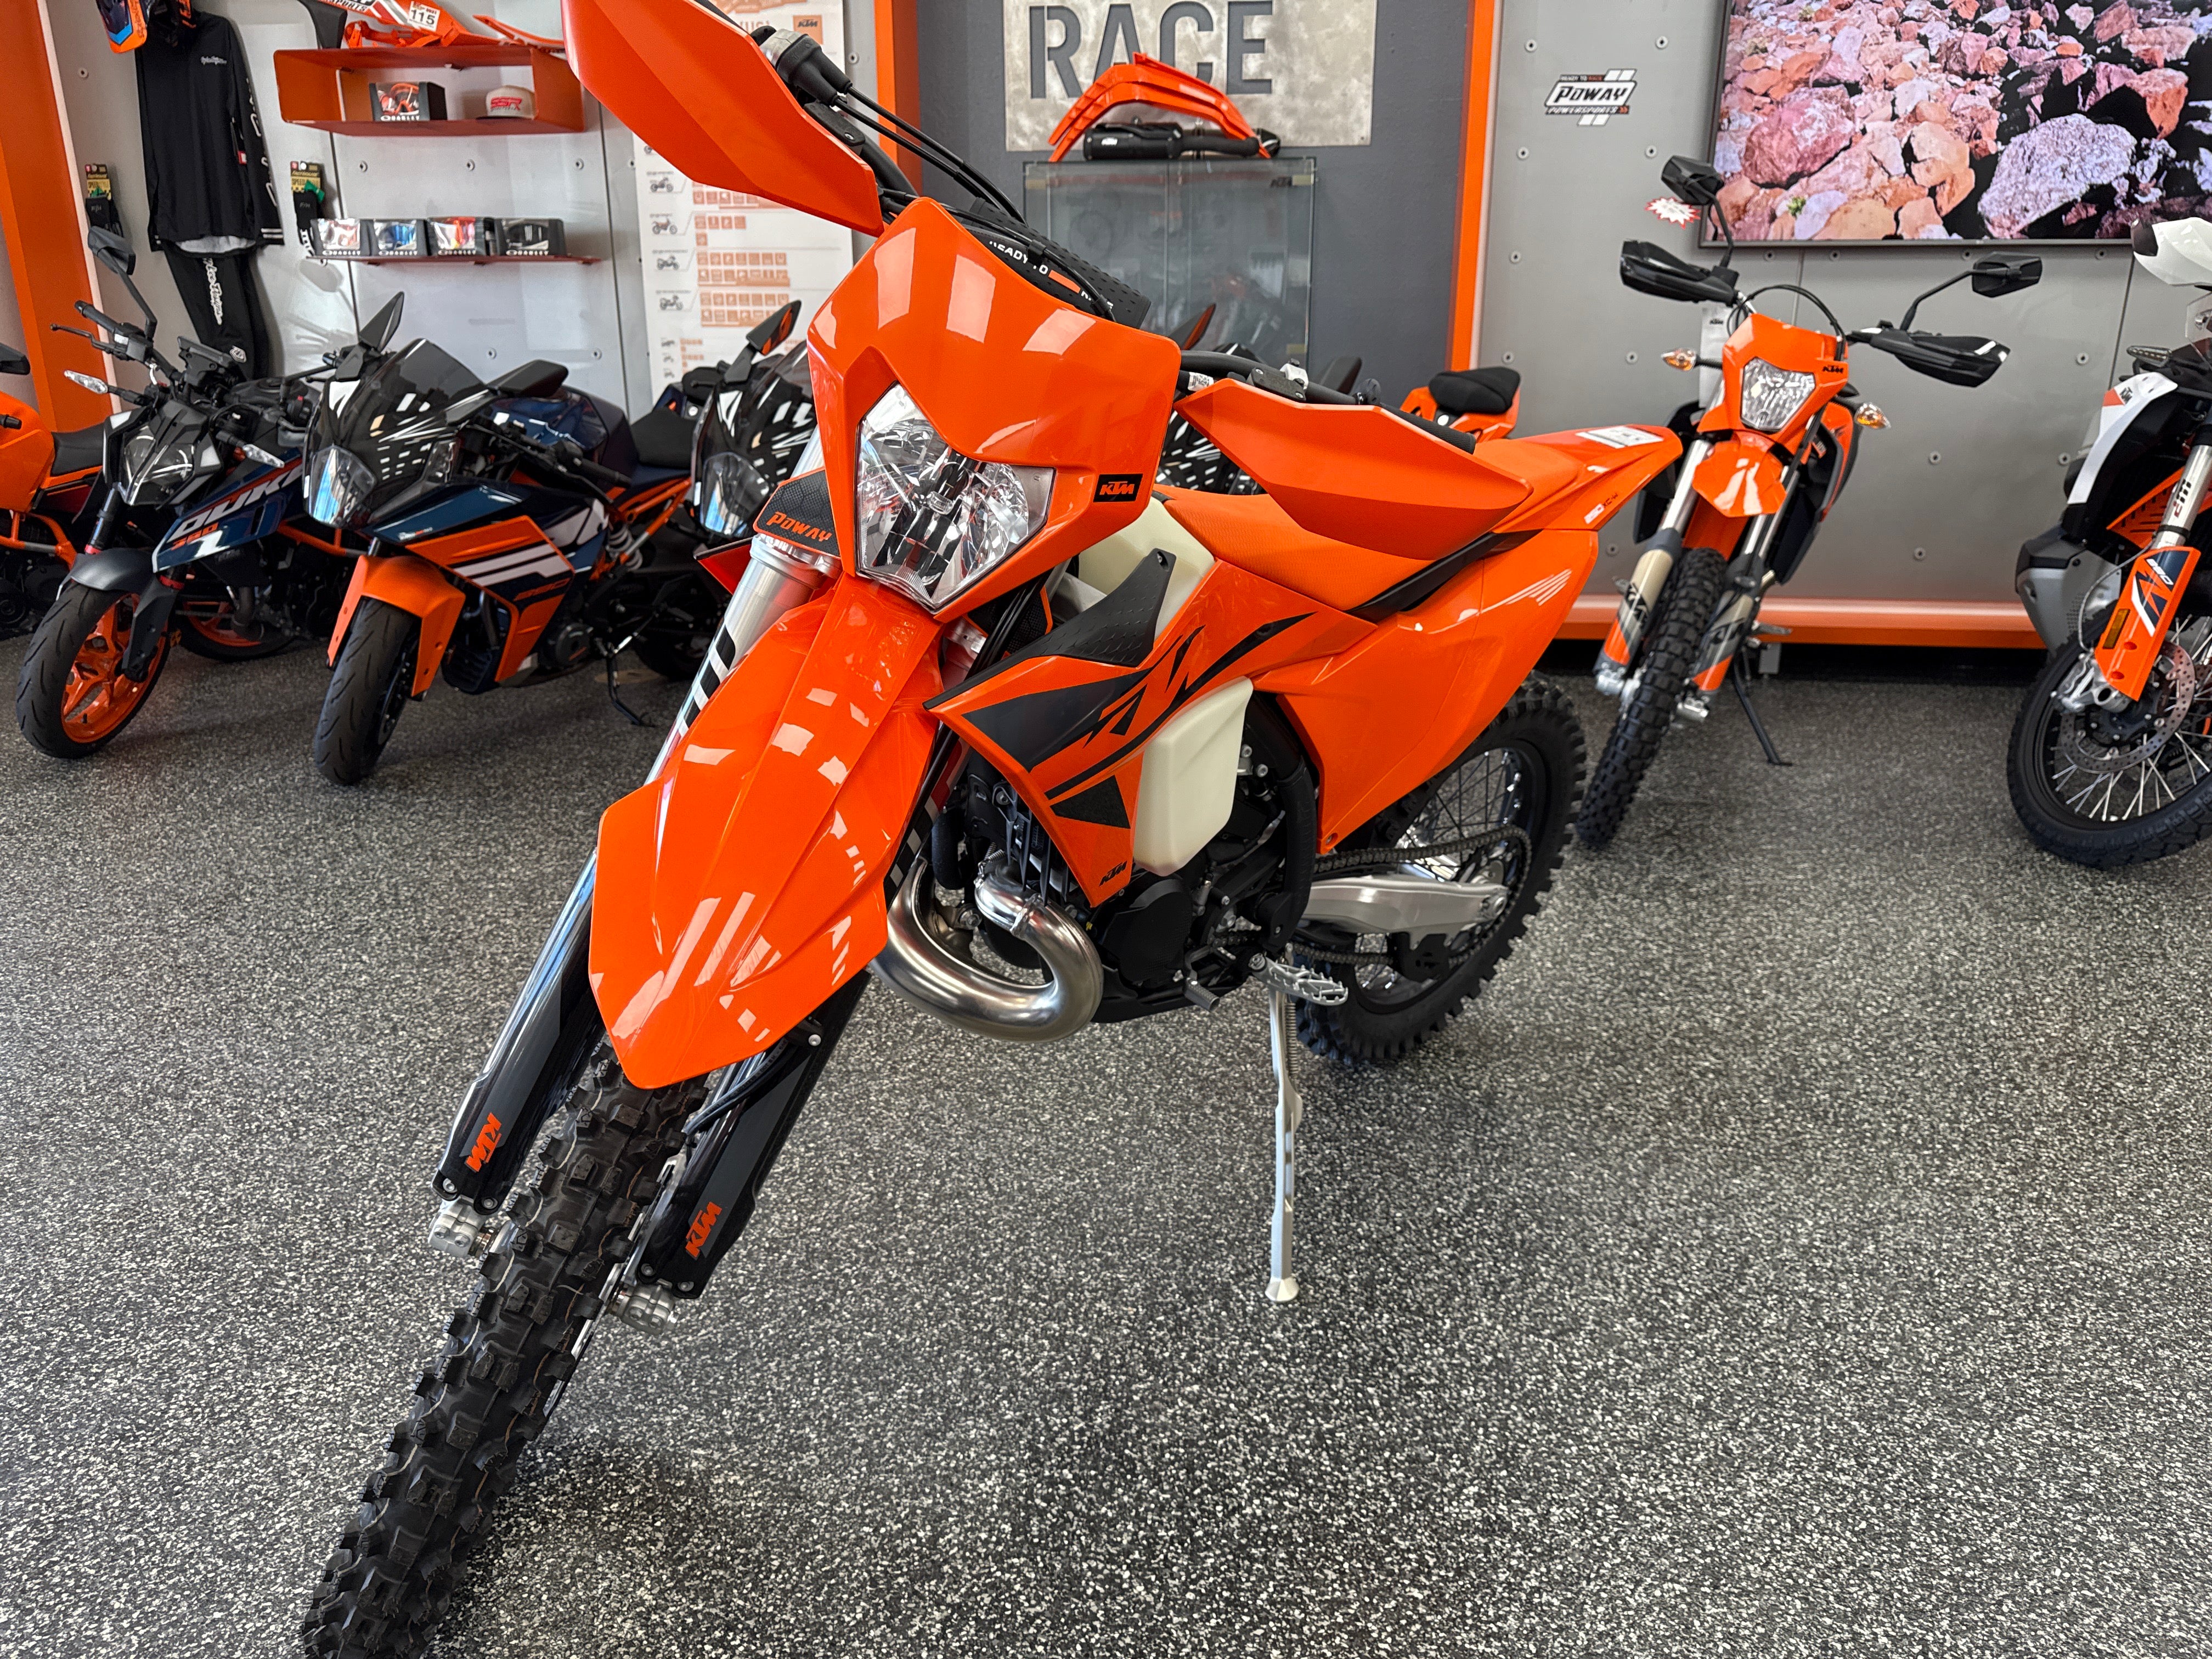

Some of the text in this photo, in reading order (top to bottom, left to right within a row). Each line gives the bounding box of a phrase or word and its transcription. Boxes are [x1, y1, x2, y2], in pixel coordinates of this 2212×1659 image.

[411, 9, 435, 25] 115
[1029, 1, 1273, 99] RACE
[1554, 86, 1628, 103] POWAY
[1822, 365, 1844, 373] KTM
[1099, 481, 1135, 495] KTM
[766, 511, 833, 541] POWAY
[1099, 860, 1128, 887] KTM
[465, 1112, 502, 1172] KTM
[685, 1201, 723, 1258] KTM
